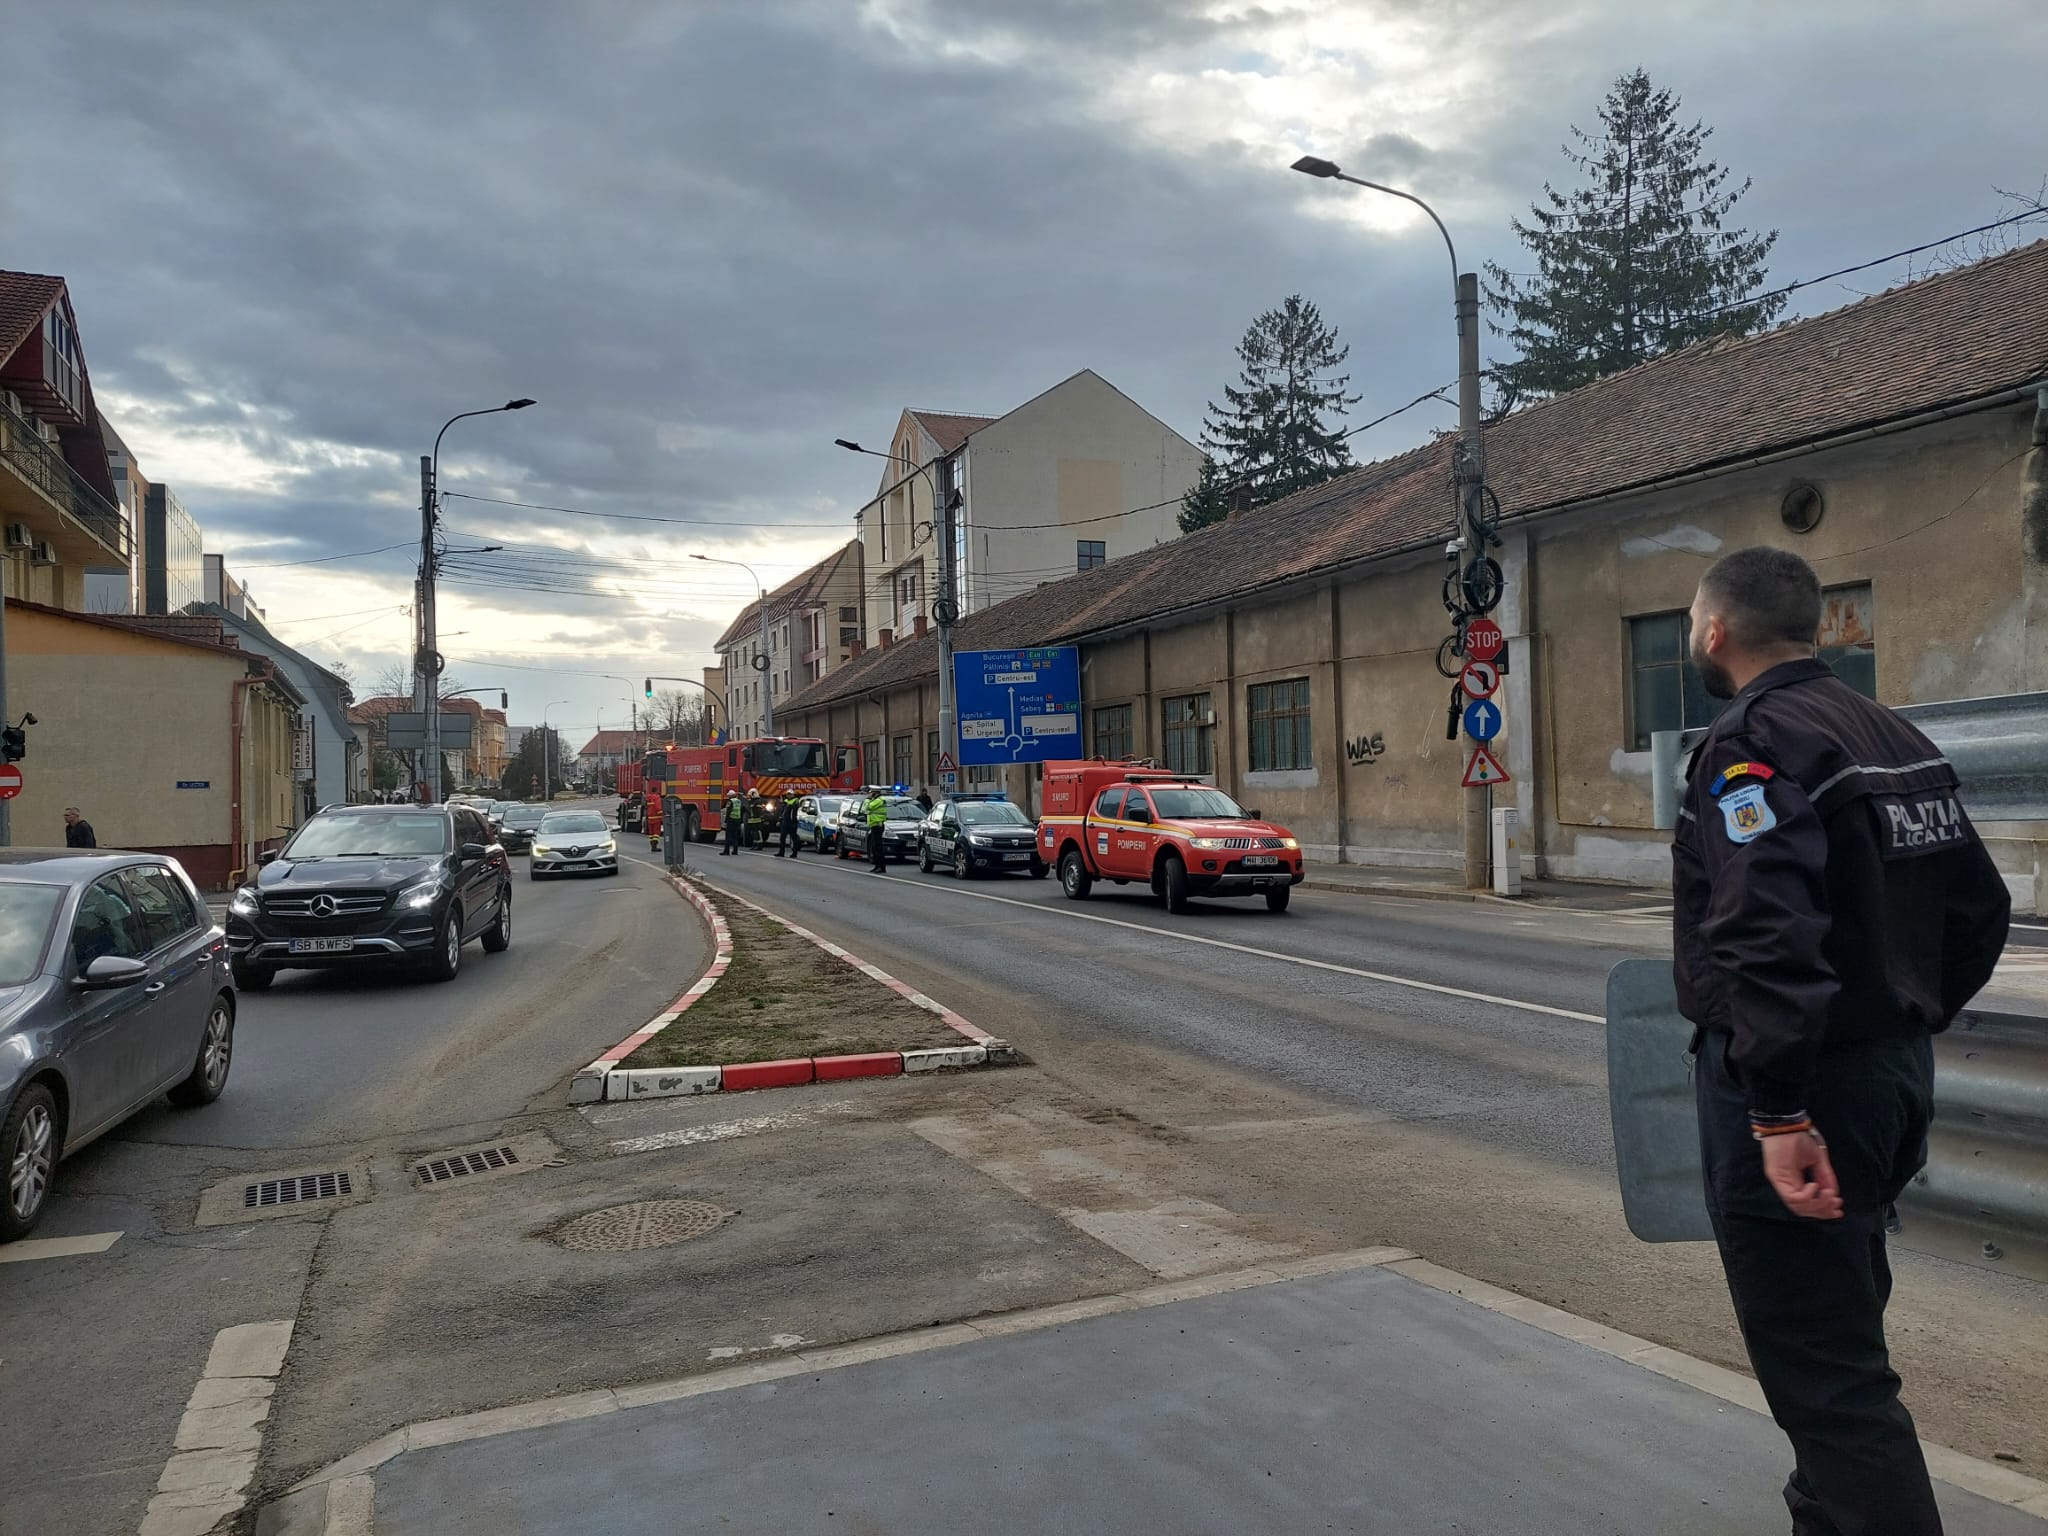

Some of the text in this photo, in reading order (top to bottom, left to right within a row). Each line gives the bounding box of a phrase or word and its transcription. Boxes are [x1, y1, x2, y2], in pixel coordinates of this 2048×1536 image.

[1467, 632, 1500, 648] STOP
[977, 721, 996, 729] Spital
[1346, 735, 1386, 760] WAS
[296, 939, 351, 951] SB 16 WFS
